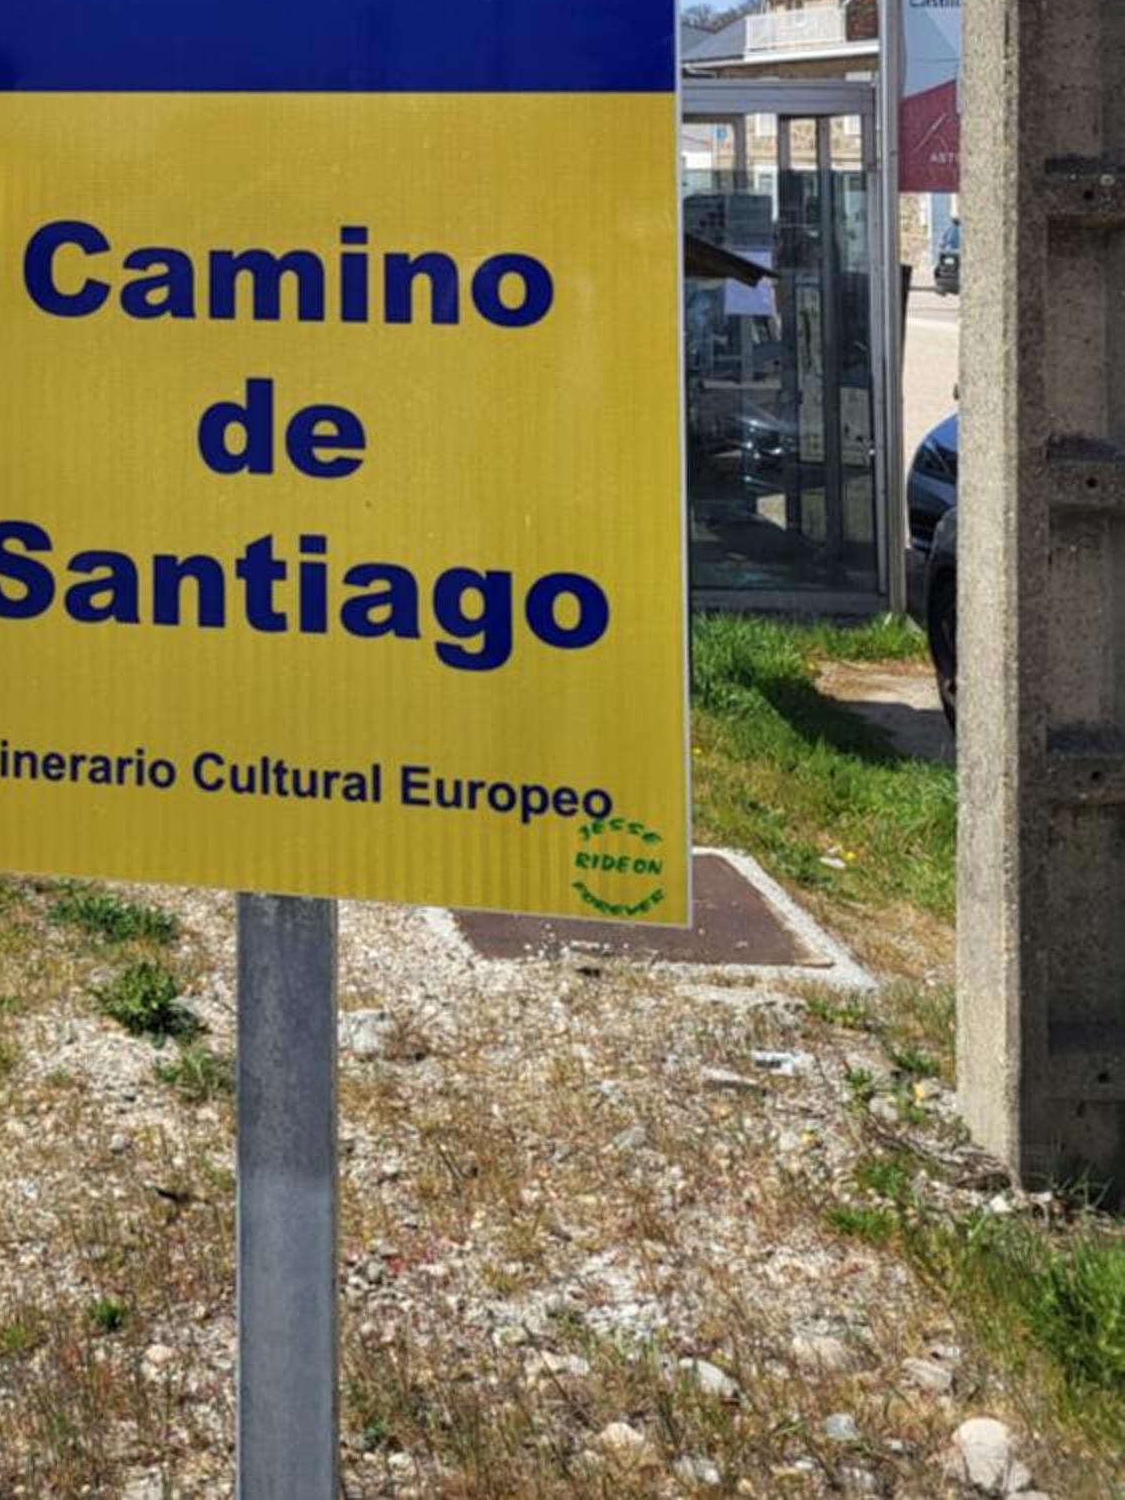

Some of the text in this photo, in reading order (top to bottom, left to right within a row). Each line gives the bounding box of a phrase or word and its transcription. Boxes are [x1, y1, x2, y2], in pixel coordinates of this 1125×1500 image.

[929, 152, 954, 164] AST
[22, 219, 555, 329] Camino
[197, 377, 367, 479] de
[192, 750, 382, 804] Cultural
[400, 765, 614, 826] Europeo
